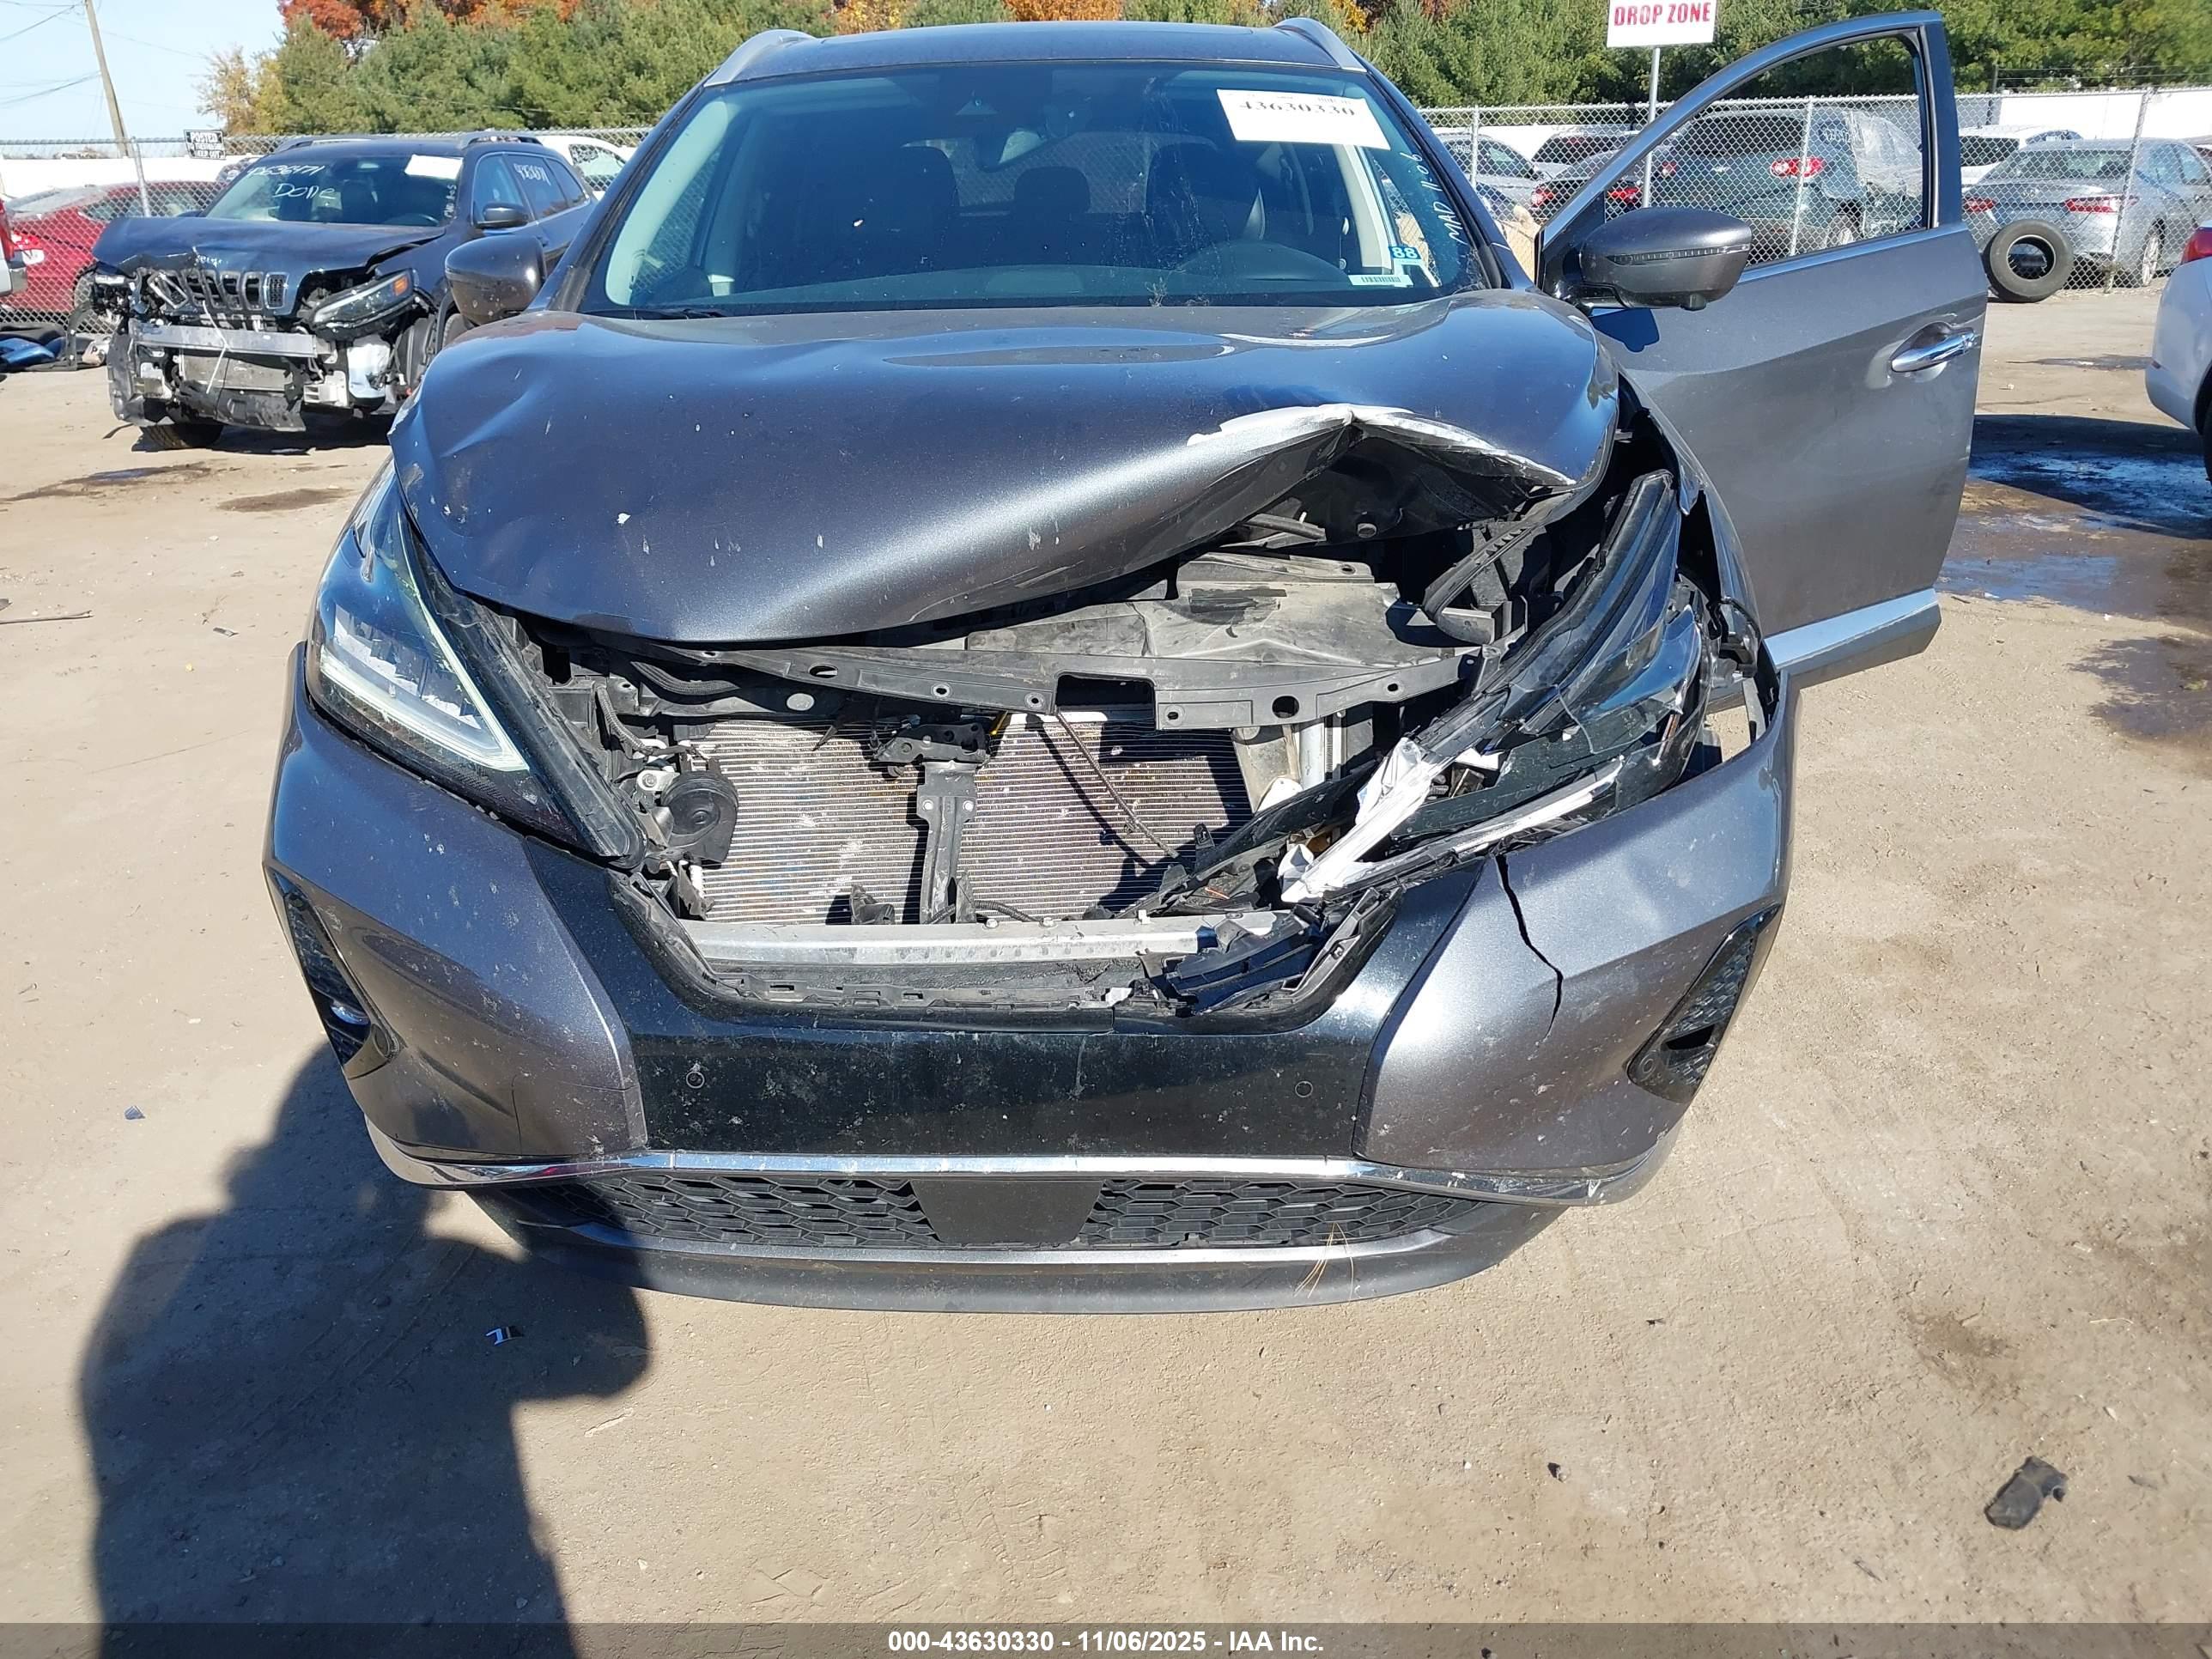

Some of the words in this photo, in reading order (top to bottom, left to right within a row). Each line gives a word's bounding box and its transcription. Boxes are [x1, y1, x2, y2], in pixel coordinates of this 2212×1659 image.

[1613, 4, 1662, 26] DROP
[1667, 2, 1711, 23] ZONE
[1432, 201, 1469, 246] MAD
[1391, 246, 1419, 258] 88
